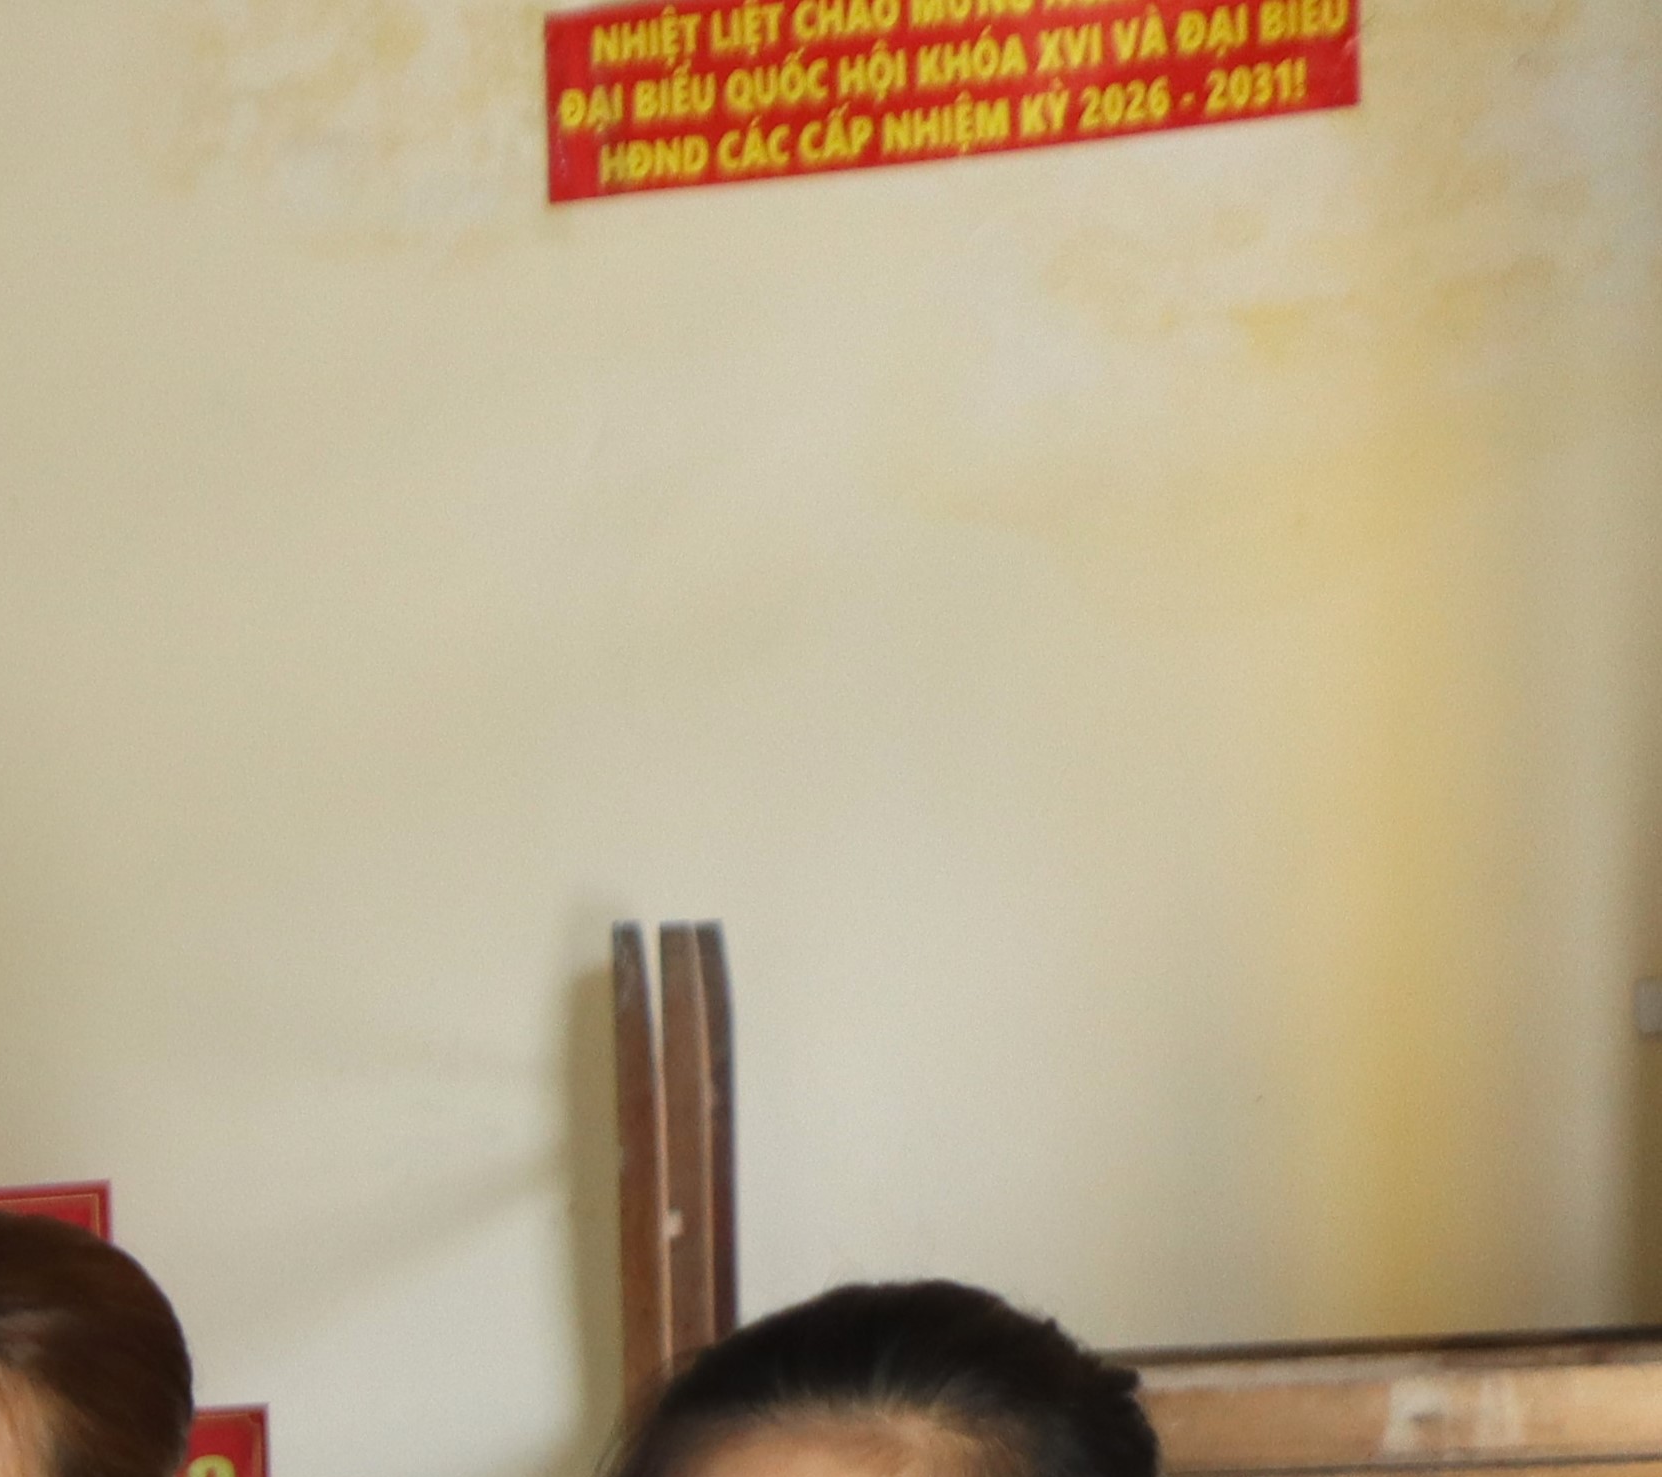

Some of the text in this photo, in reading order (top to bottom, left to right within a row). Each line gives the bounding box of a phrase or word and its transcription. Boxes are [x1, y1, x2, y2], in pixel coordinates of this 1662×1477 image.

[559, 83, 624, 132] ĐẠI
[725, 45, 830, 113] QUỐC
[837, 38, 908, 102] HỘI
[917, 24, 1027, 88] KHÓA
[1038, 22, 1104, 72] XVI
[1114, 3, 1169, 63] VÀ
[1176, 3, 1249, 58] ĐẠI
[591, 4, 702, 67] NHIỆT
[712, 0, 785, 56] LIỆT
[600, 135, 710, 187] HĐND
[717, 115, 792, 172] CÁC
[798, 102, 875, 163] CẤP
[882, 91, 1012, 154] NHIỆM
[1077, 76, 1173, 131] 2026
[1205, 56, 1309, 116] 2031!
